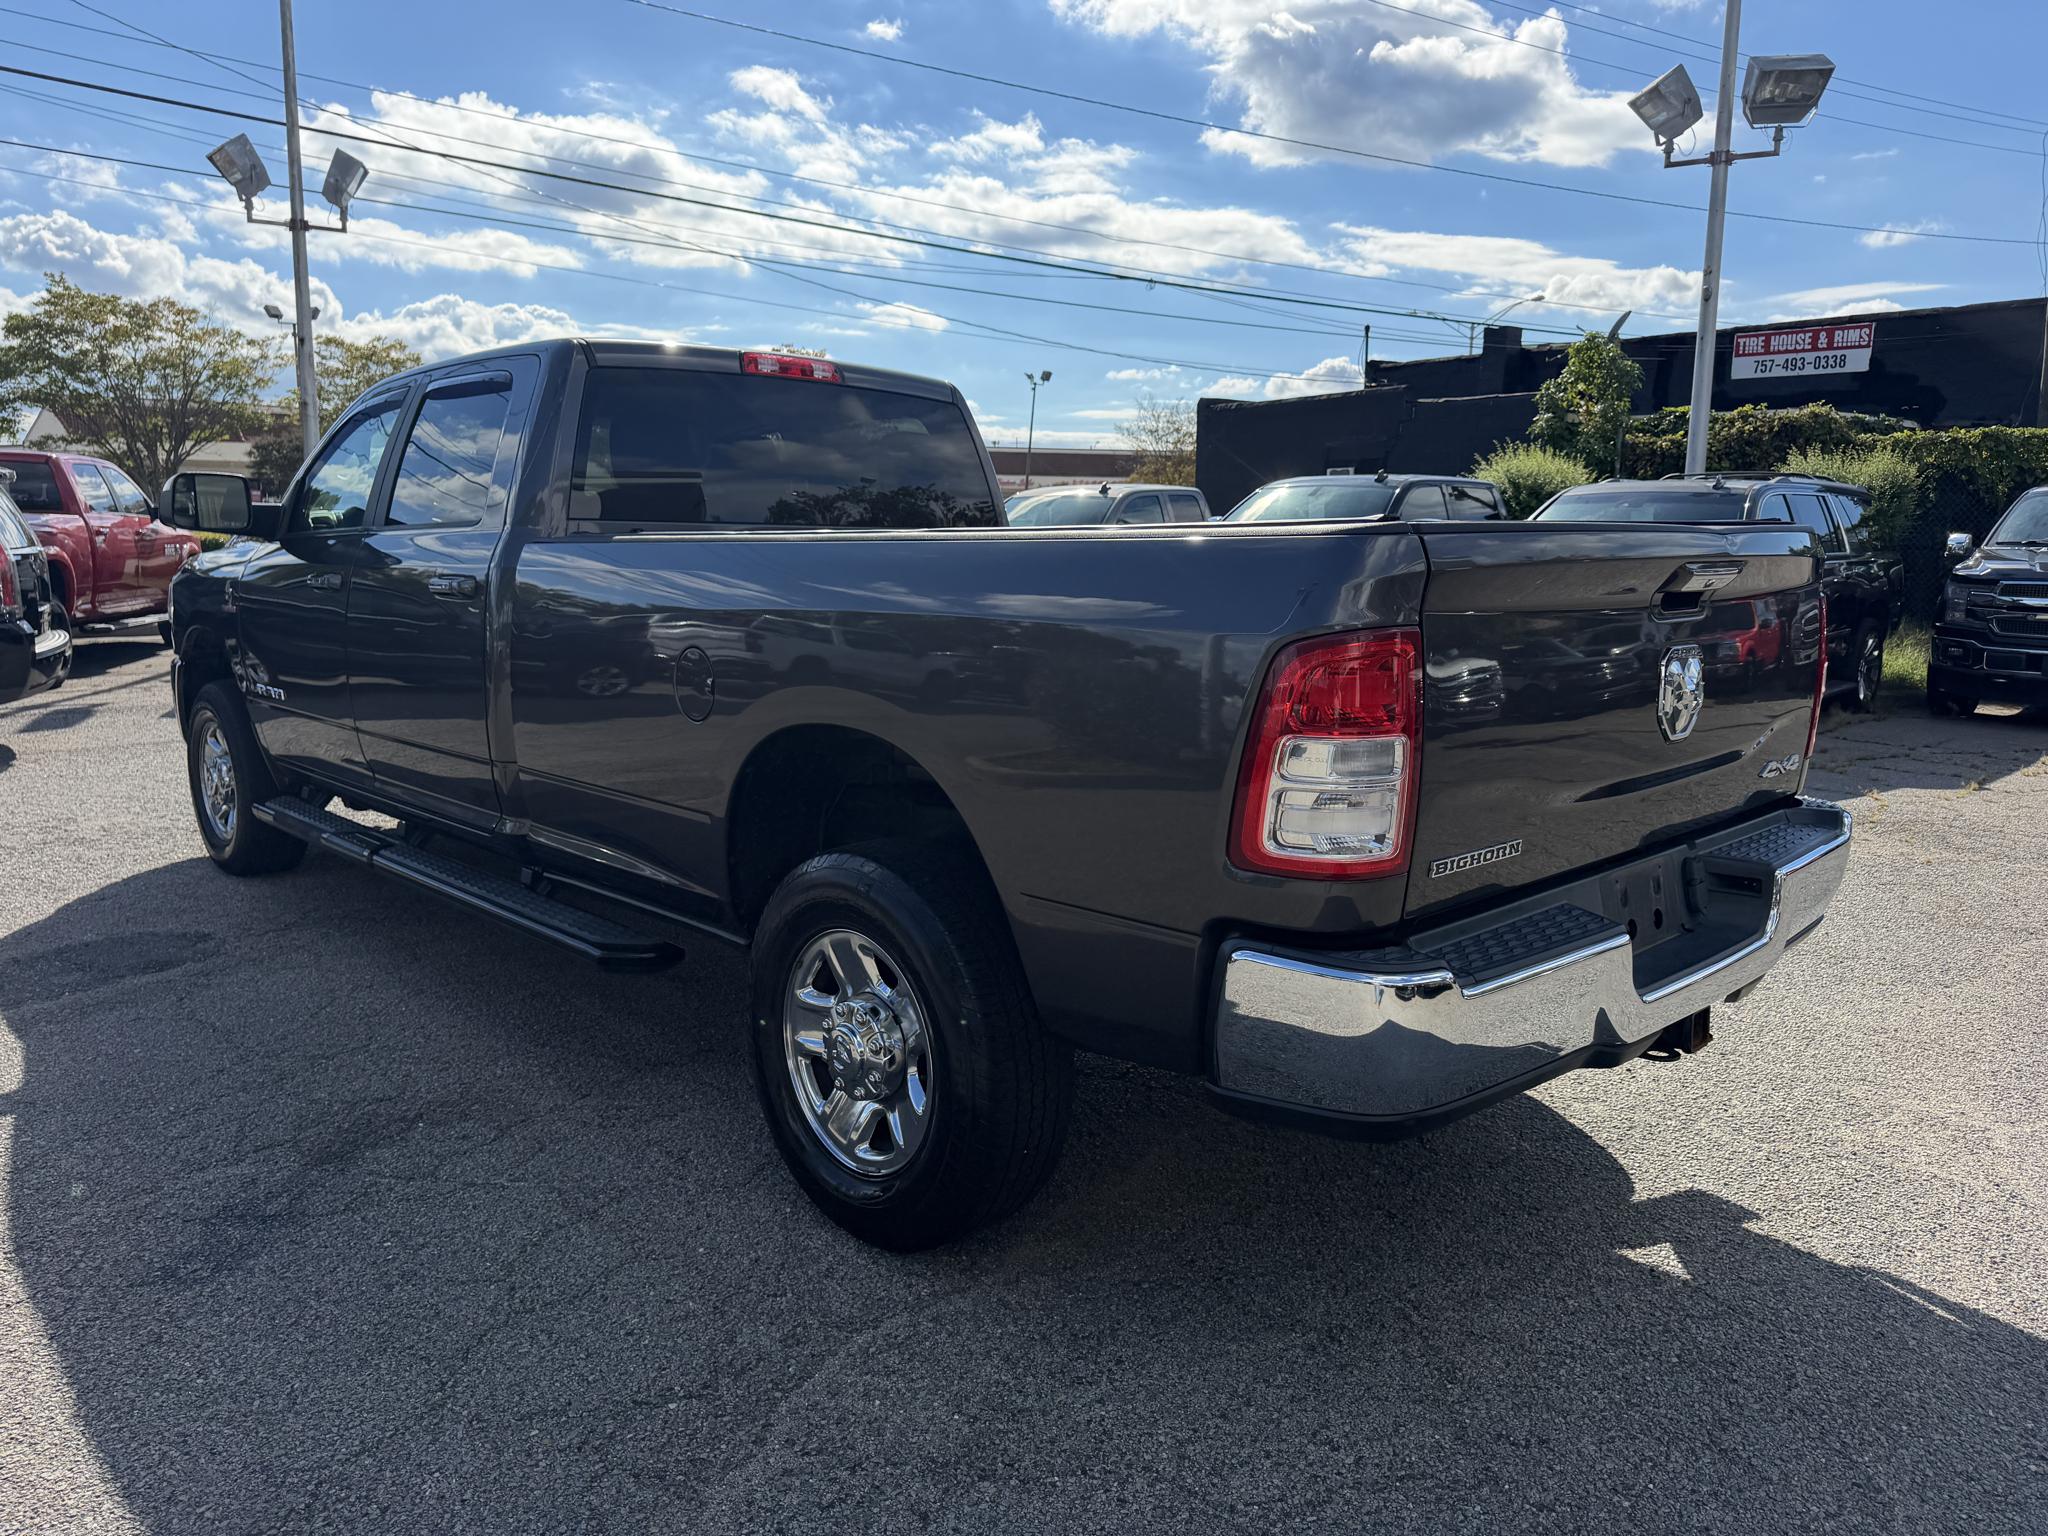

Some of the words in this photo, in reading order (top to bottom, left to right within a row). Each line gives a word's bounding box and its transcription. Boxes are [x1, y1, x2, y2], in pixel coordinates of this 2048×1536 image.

[1738, 336, 1765, 354] TIRE
[1770, 332, 1813, 352] HOUSE
[1817, 331, 1828, 348] &
[1834, 328, 1870, 347] RIMS
[1753, 354, 1847, 374] 757-493-0338
[1431, 839, 1523, 878] BIGHORN
